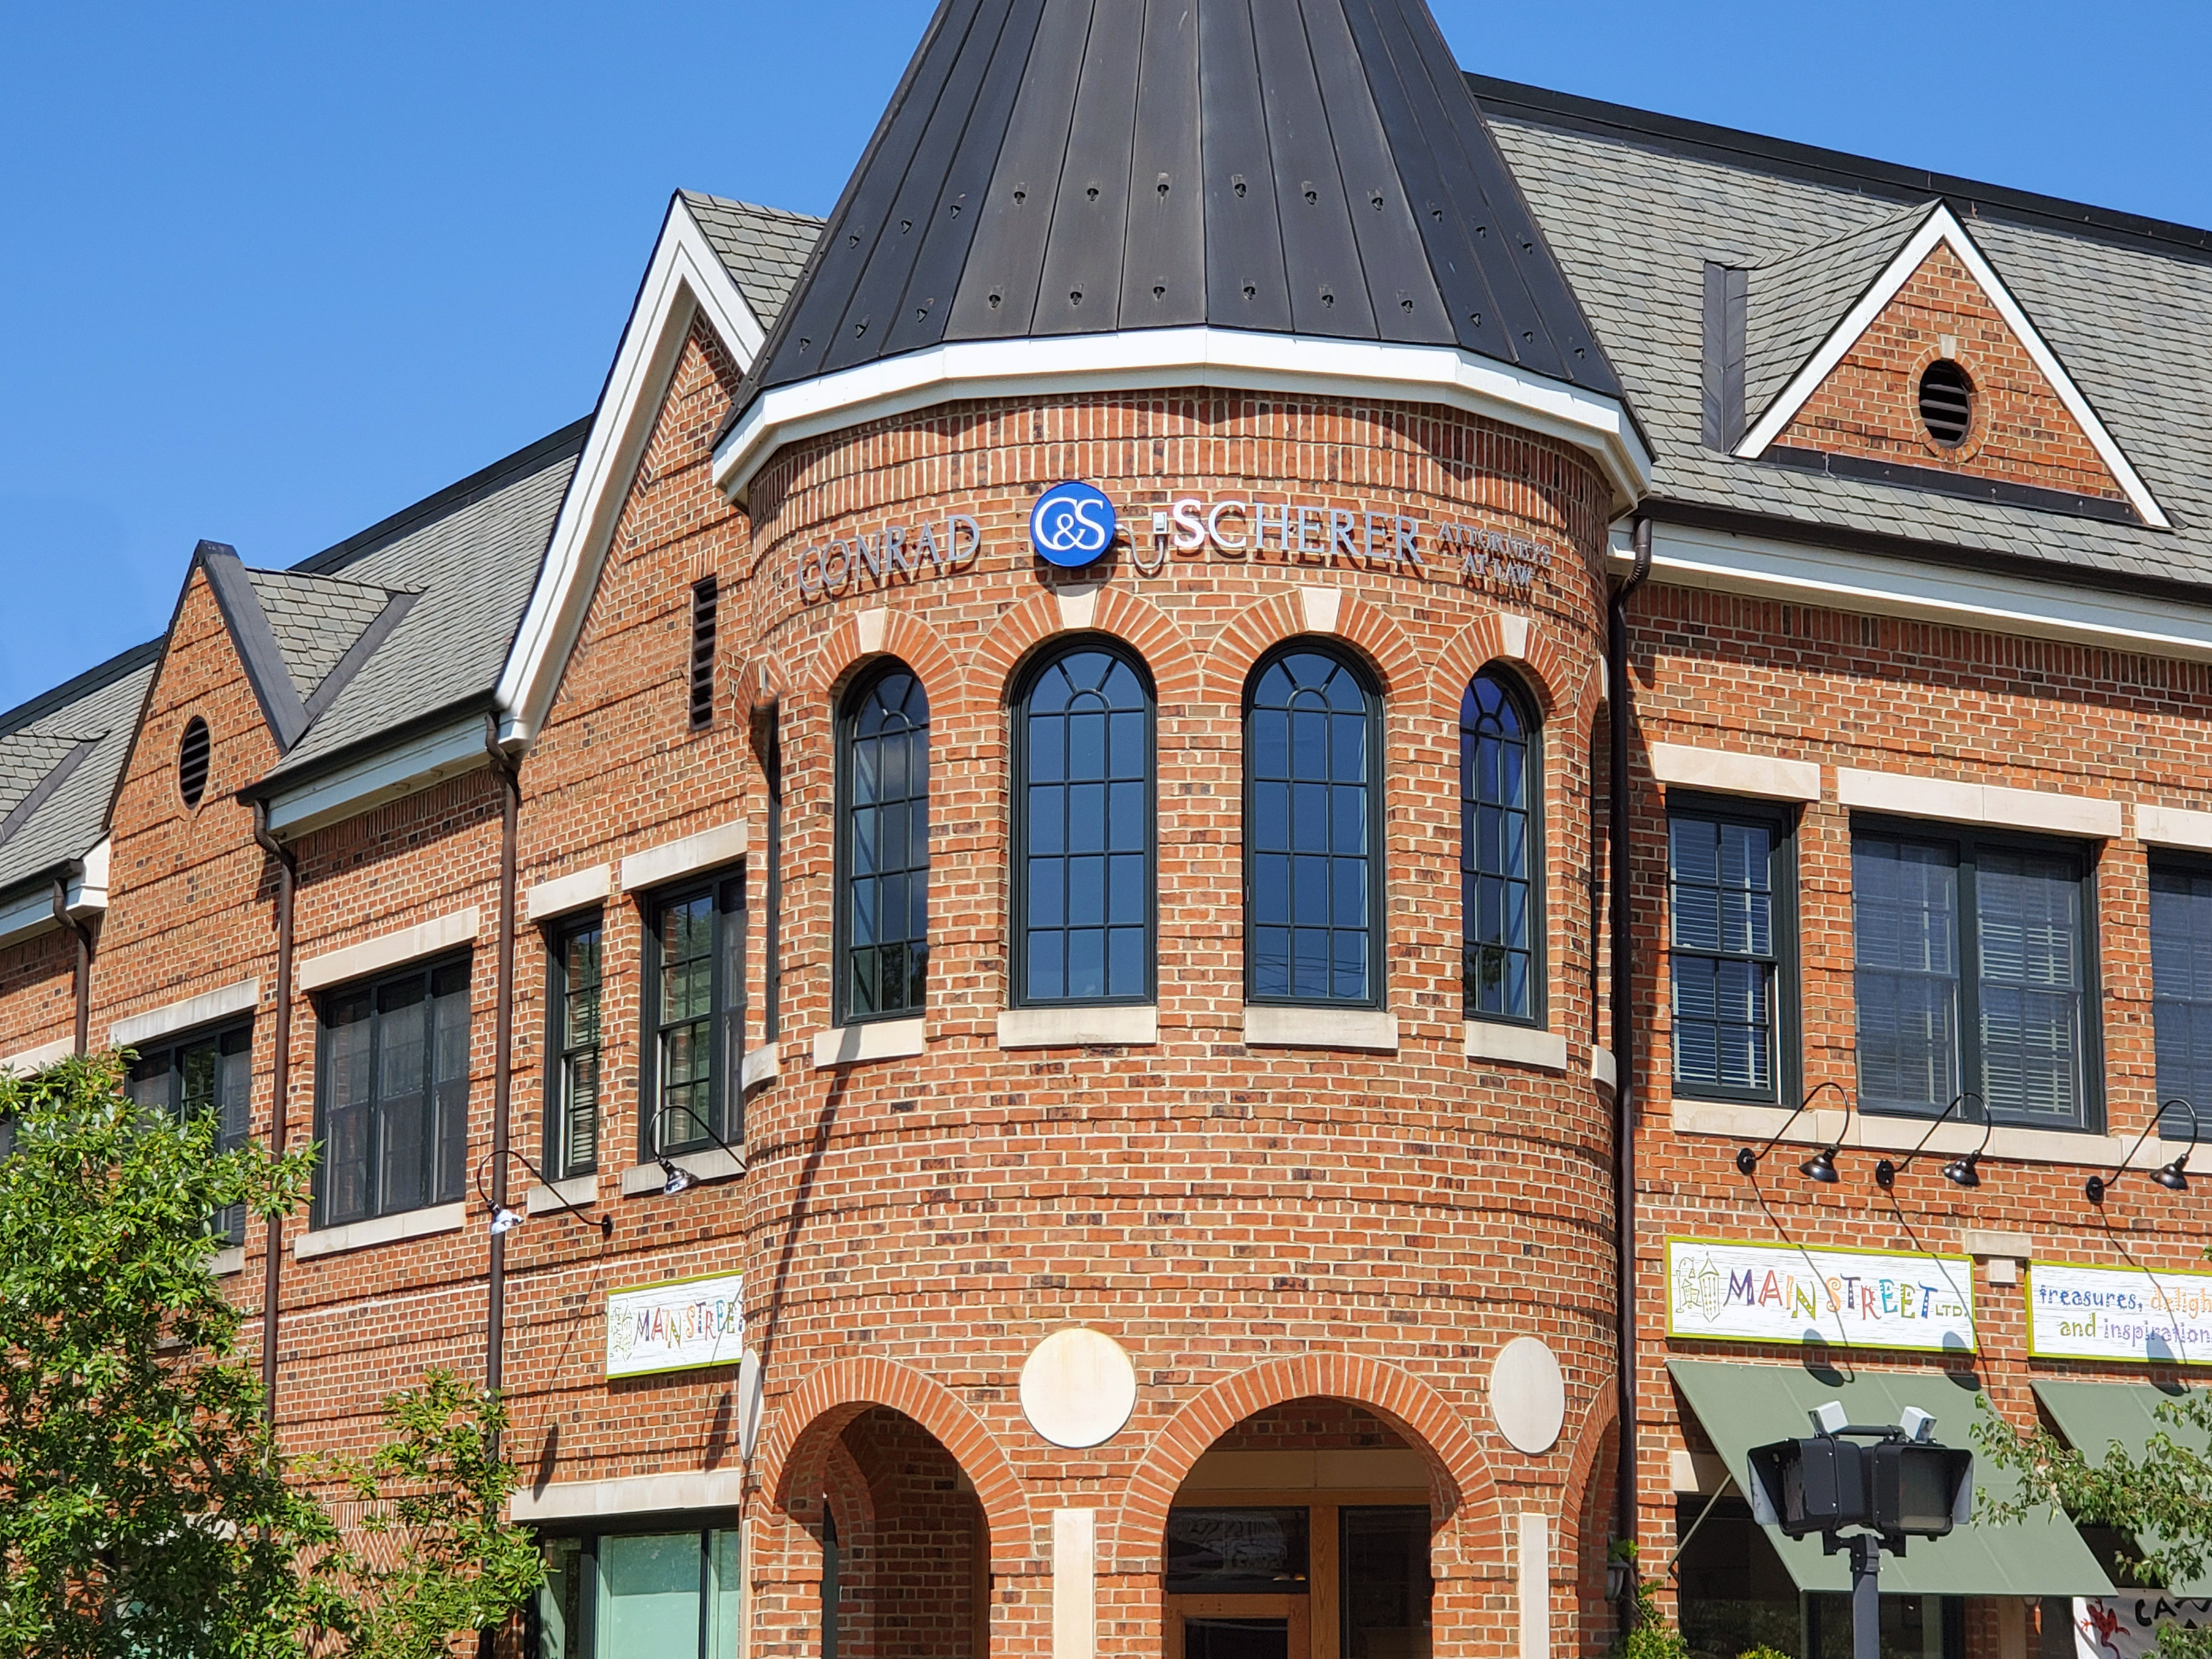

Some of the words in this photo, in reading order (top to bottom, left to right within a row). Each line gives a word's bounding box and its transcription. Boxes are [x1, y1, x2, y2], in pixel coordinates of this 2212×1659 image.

[797, 514, 981, 592] CONRAD
[1035, 497, 1105, 550] C&S
[1173, 499, 1425, 564] SCHERER
[1437, 520, 1551, 566] ATTORNEYS
[1462, 552, 1487, 574] AT
[1493, 558, 1534, 587] LAW
[2039, 1285, 2143, 1312] treasures,
[2060, 1312, 2096, 1338] and
[2103, 1318, 2212, 1347] inspiration
